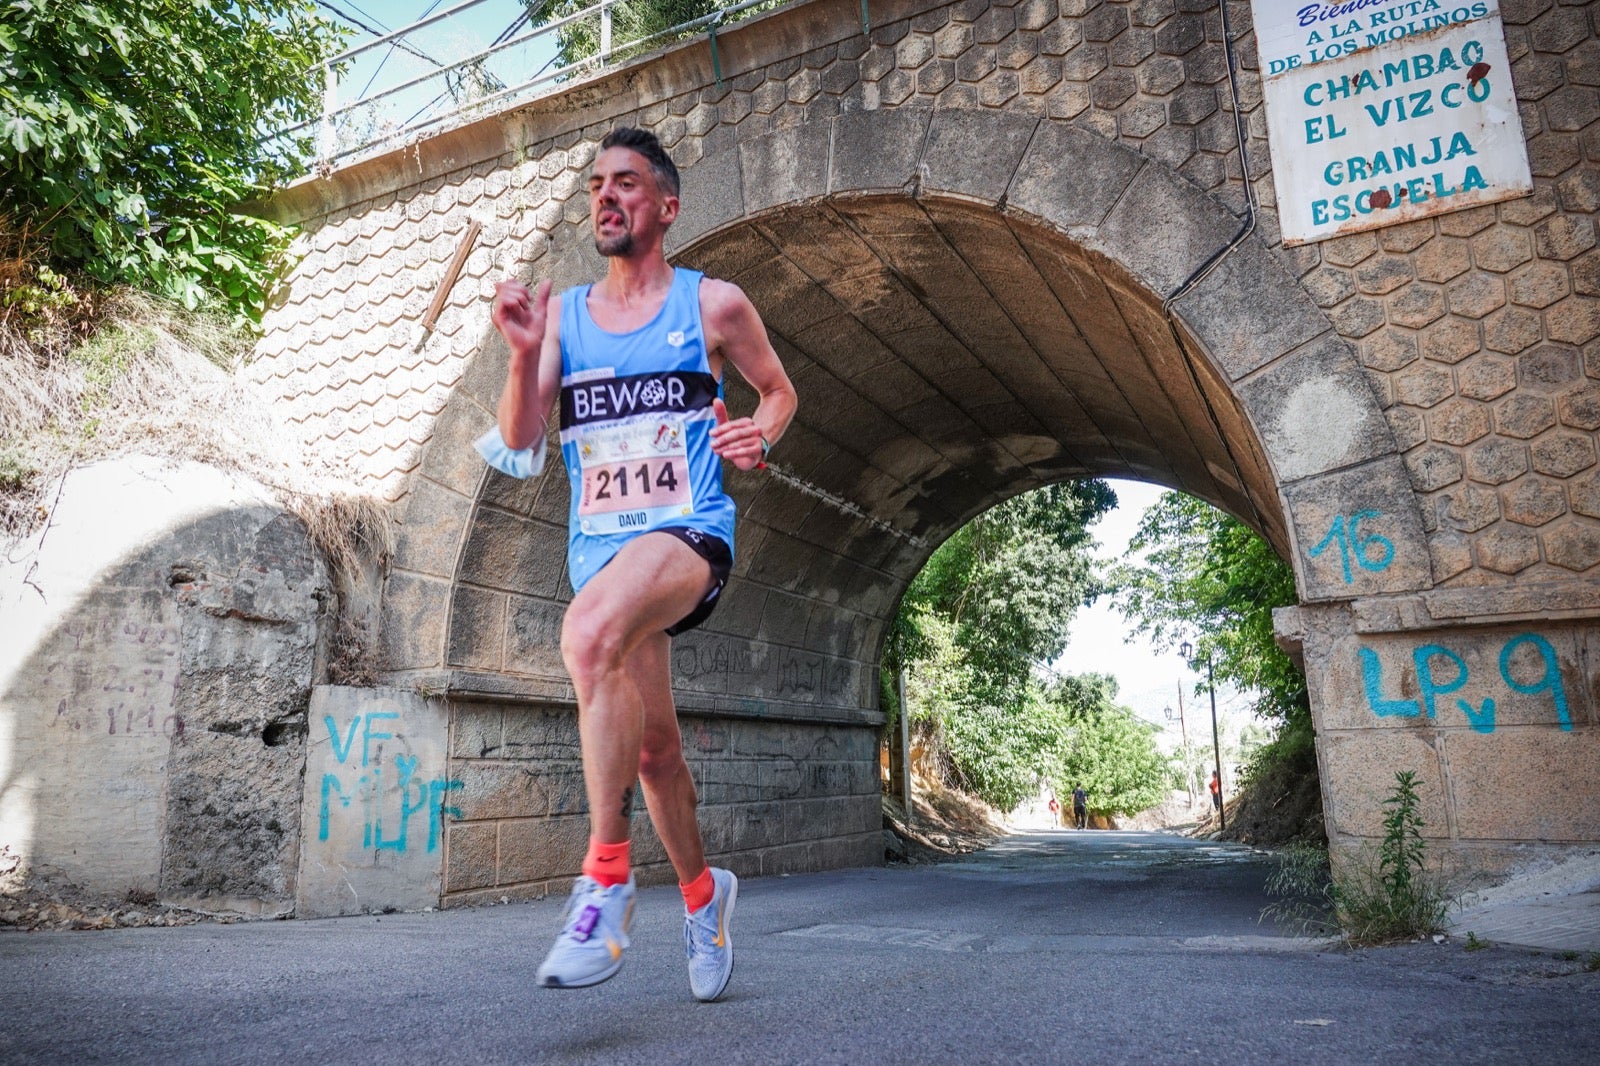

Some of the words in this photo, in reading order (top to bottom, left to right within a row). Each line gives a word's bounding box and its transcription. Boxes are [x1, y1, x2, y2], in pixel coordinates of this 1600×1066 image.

[1269, 53, 1302, 75] DE
[1309, 38, 1358, 63] LOS
[1366, 2, 1489, 47] MOLINOS
[1296, 0, 1388, 27] Bienv
[1306, 30, 1325, 46] A
[1331, 18, 1363, 39] LA
[1369, 0, 1441, 28] RUTA
[1304, 114, 1347, 145] EL
[1364, 77, 1491, 127] VIZCO
[1323, 131, 1478, 187] GRANJA
[1311, 165, 1489, 226] ESCUELA
[595, 461, 678, 500] 2114
[618, 512, 647, 527] DAVID
[1309, 508, 1396, 585] 16
[323, 711, 400, 768] VF
